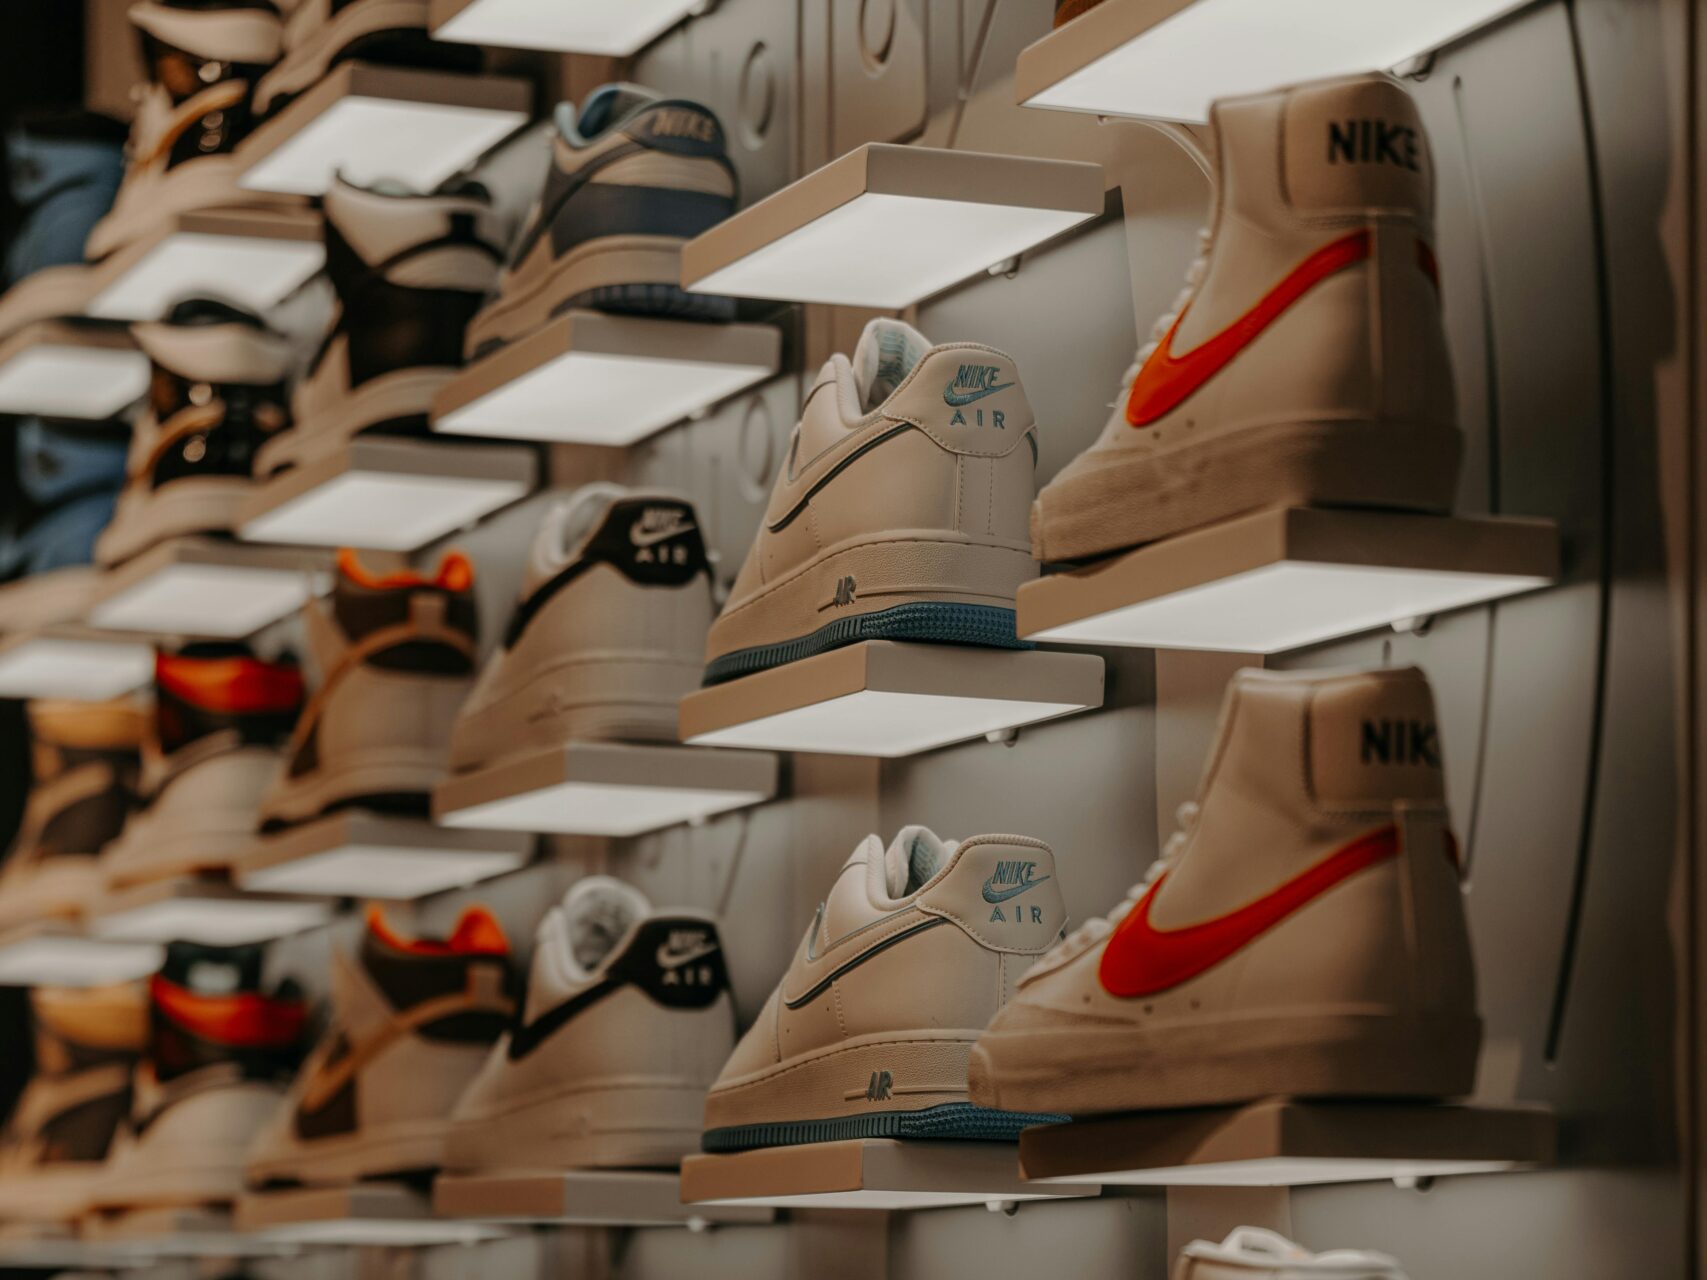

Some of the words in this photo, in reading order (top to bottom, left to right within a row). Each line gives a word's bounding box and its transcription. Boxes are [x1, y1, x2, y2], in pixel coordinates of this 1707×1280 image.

[1327, 119, 1420, 172] NIKE
[953, 364, 1000, 389] NIKE
[950, 409, 1005, 430] AIR
[1361, 718, 1441, 769] NIK
[992, 861, 1036, 886] NIKE
[990, 905, 1042, 924] AIR
